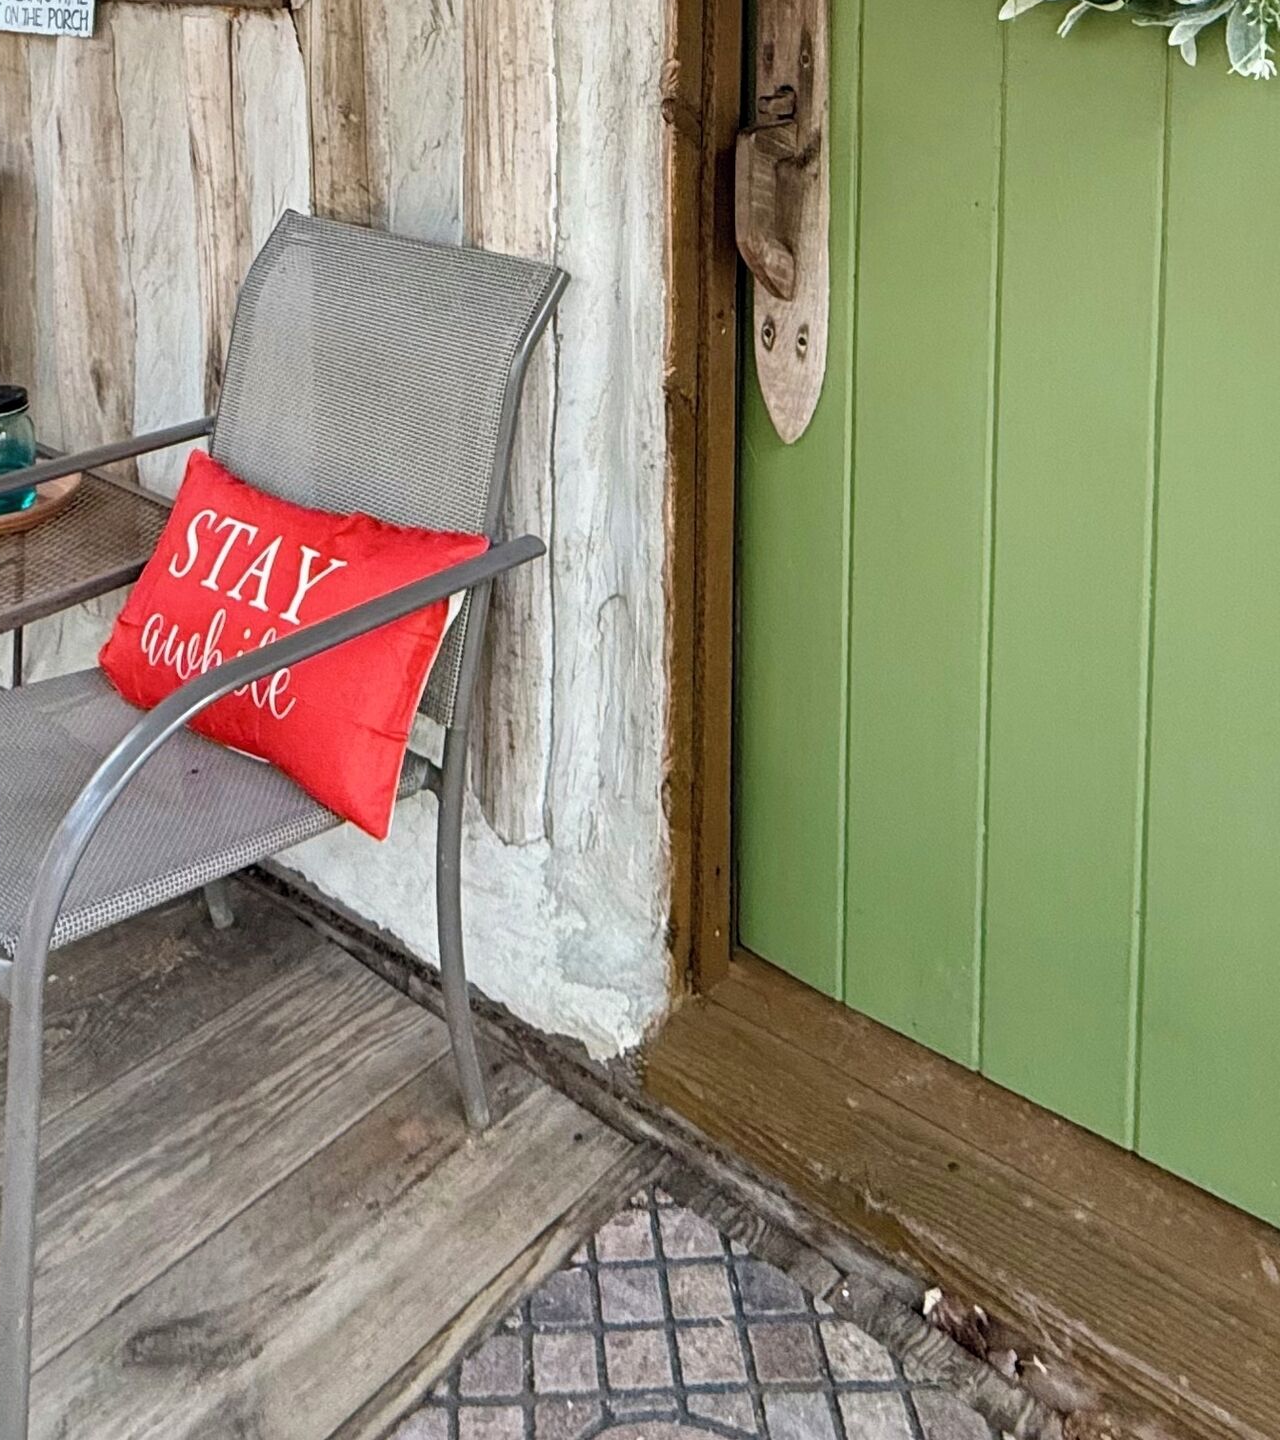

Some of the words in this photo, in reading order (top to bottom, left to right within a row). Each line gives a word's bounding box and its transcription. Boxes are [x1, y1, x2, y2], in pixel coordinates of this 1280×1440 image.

[4, 5, 19, 25] ON
[21, 7, 43, 27] THE
[47, 7, 89, 32] PORCH
[167, 508, 348, 625] STAY
